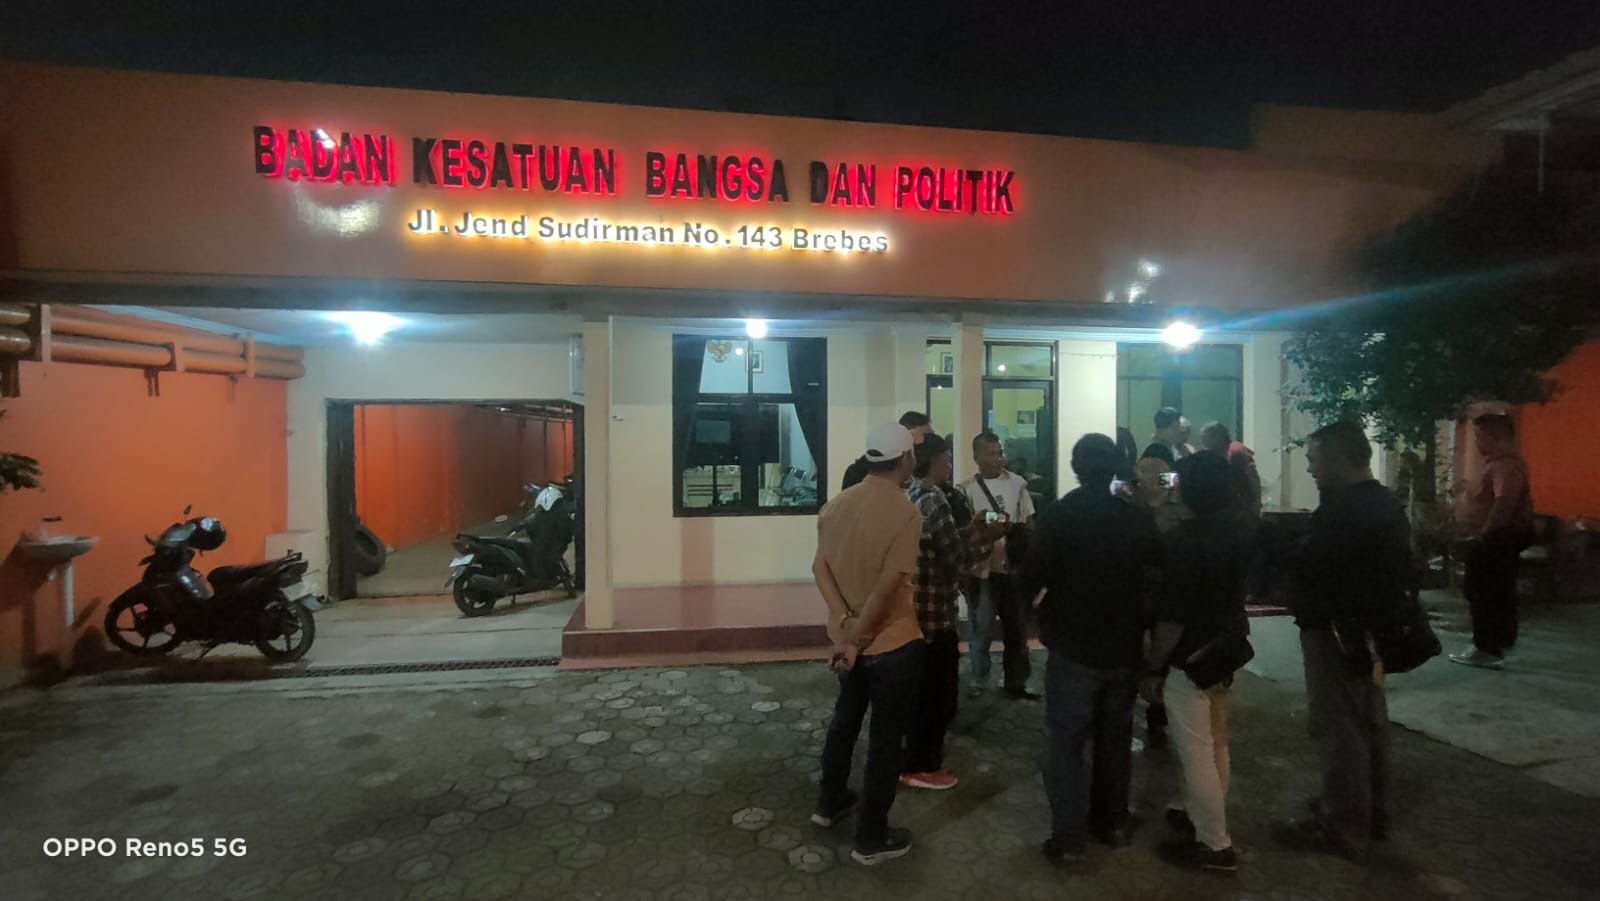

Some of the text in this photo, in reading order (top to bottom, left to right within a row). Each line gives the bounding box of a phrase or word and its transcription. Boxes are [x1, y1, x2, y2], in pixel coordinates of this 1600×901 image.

[254, 126, 1015, 213] BADAN KESATUAN BANGSA DAN POLITIK
[455, 211, 528, 238] Jend
[538, 215, 674, 245] Sudirman
[683, 222, 731, 246] No.
[738, 224, 783, 248] 143
[792, 227, 890, 253] Brebes
